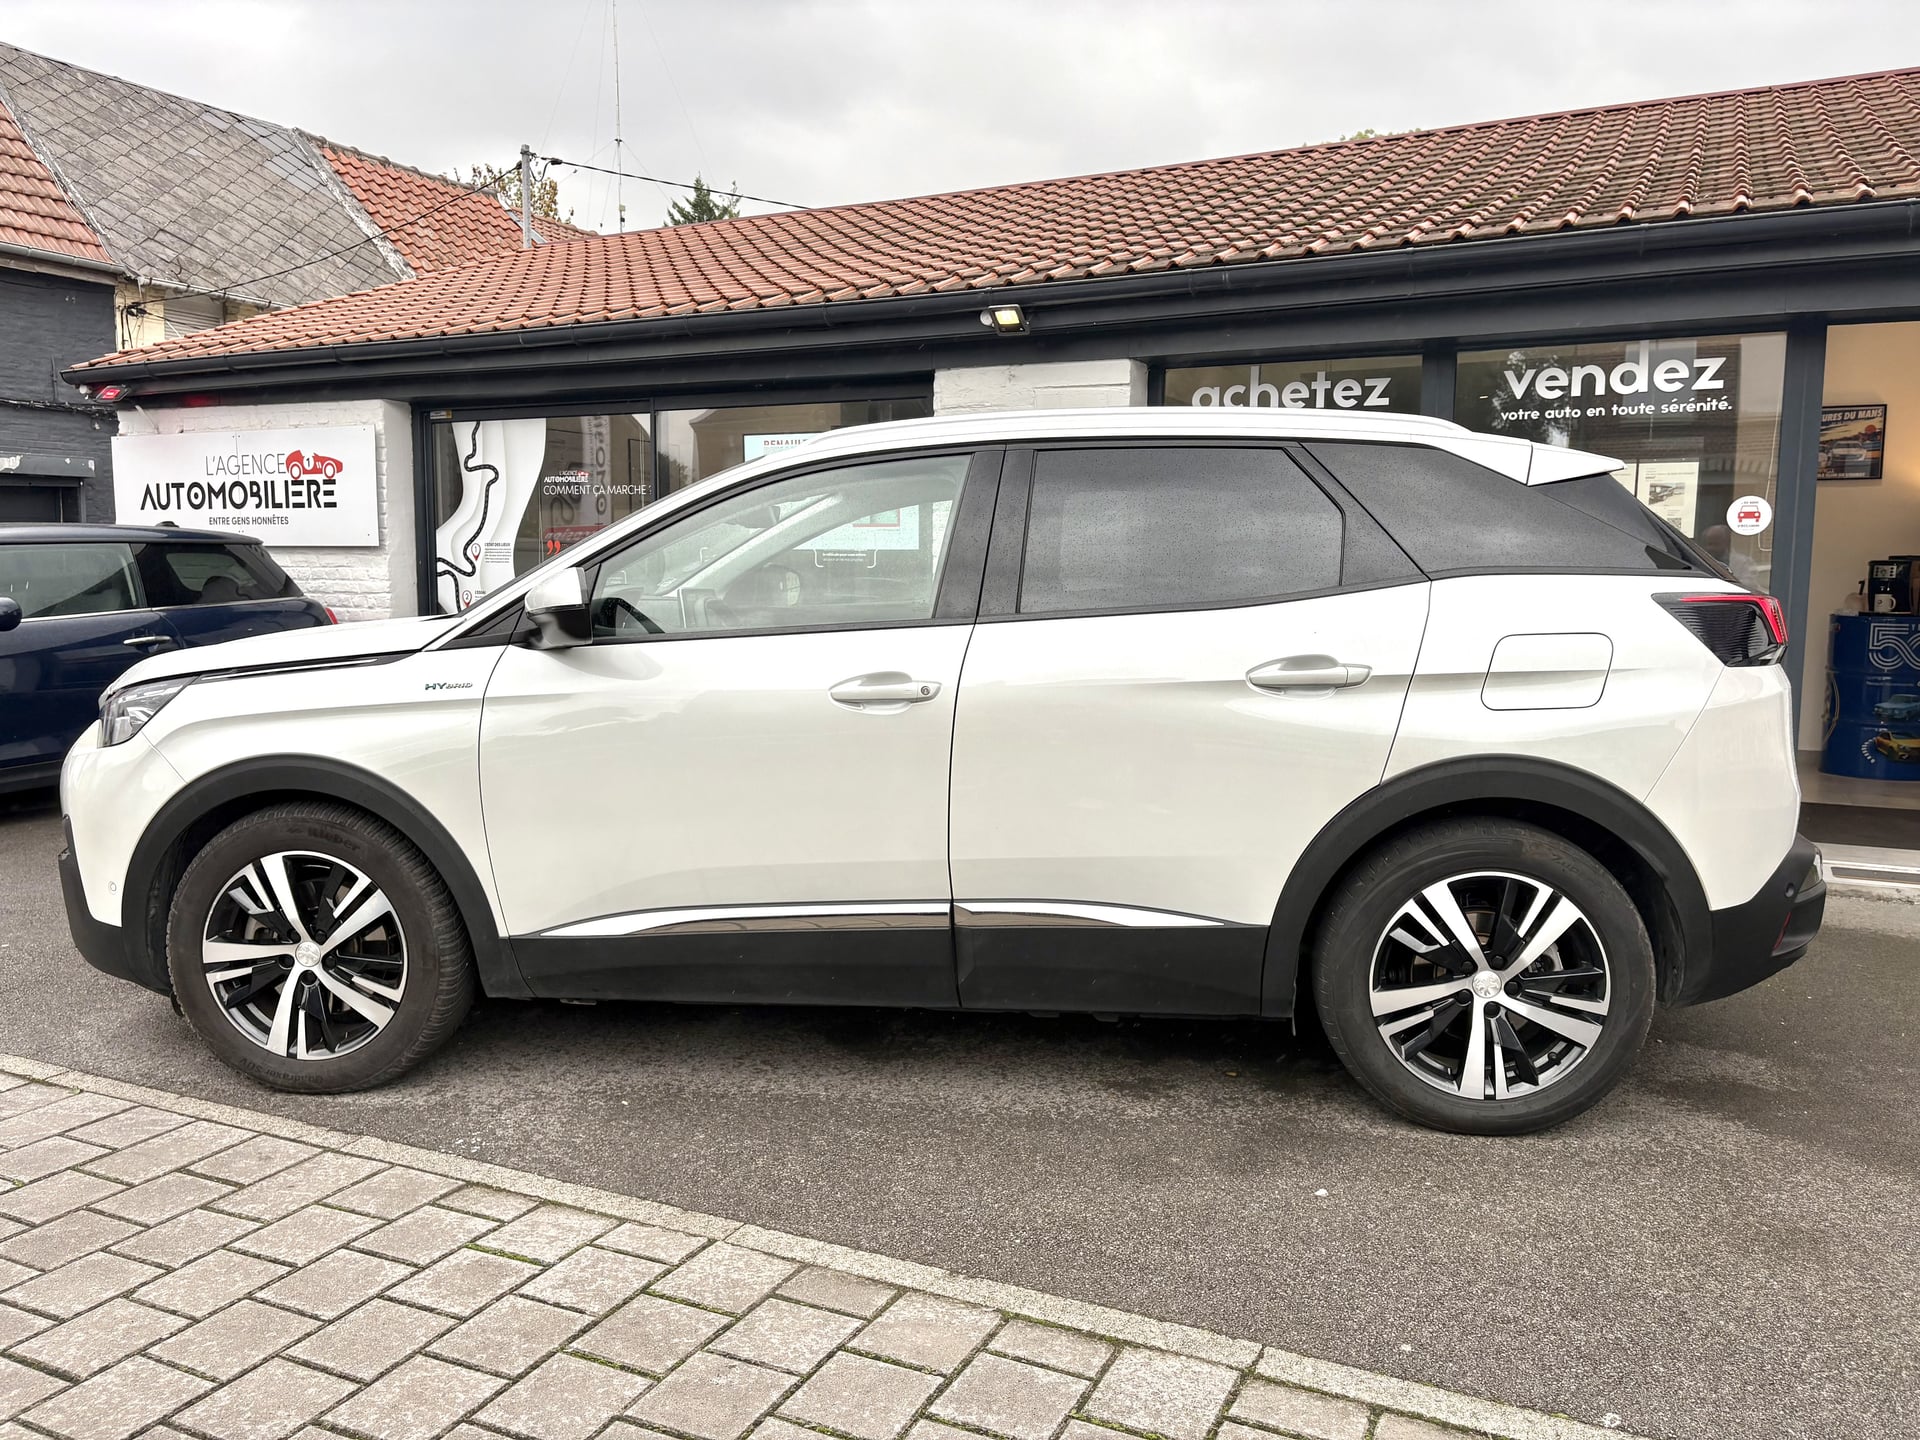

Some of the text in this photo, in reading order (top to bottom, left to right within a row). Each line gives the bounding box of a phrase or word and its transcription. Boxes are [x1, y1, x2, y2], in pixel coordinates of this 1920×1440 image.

[1504, 341, 1727, 400] vendez
[1191, 365, 1392, 408] achetez
[1500, 396, 1733, 421] votre auto en toute sérénité.
[1843, 411, 1857, 420] DU
[1858, 408, 1883, 419] MANS
[206, 453, 286, 476] L'AGENCE
[543, 484, 591, 495] COMMENT
[592, 484, 606, 497] ÇA
[607, 484, 647, 495] MARCHE
[209, 514, 290, 525] ENTRE GENS HONNÊTES
